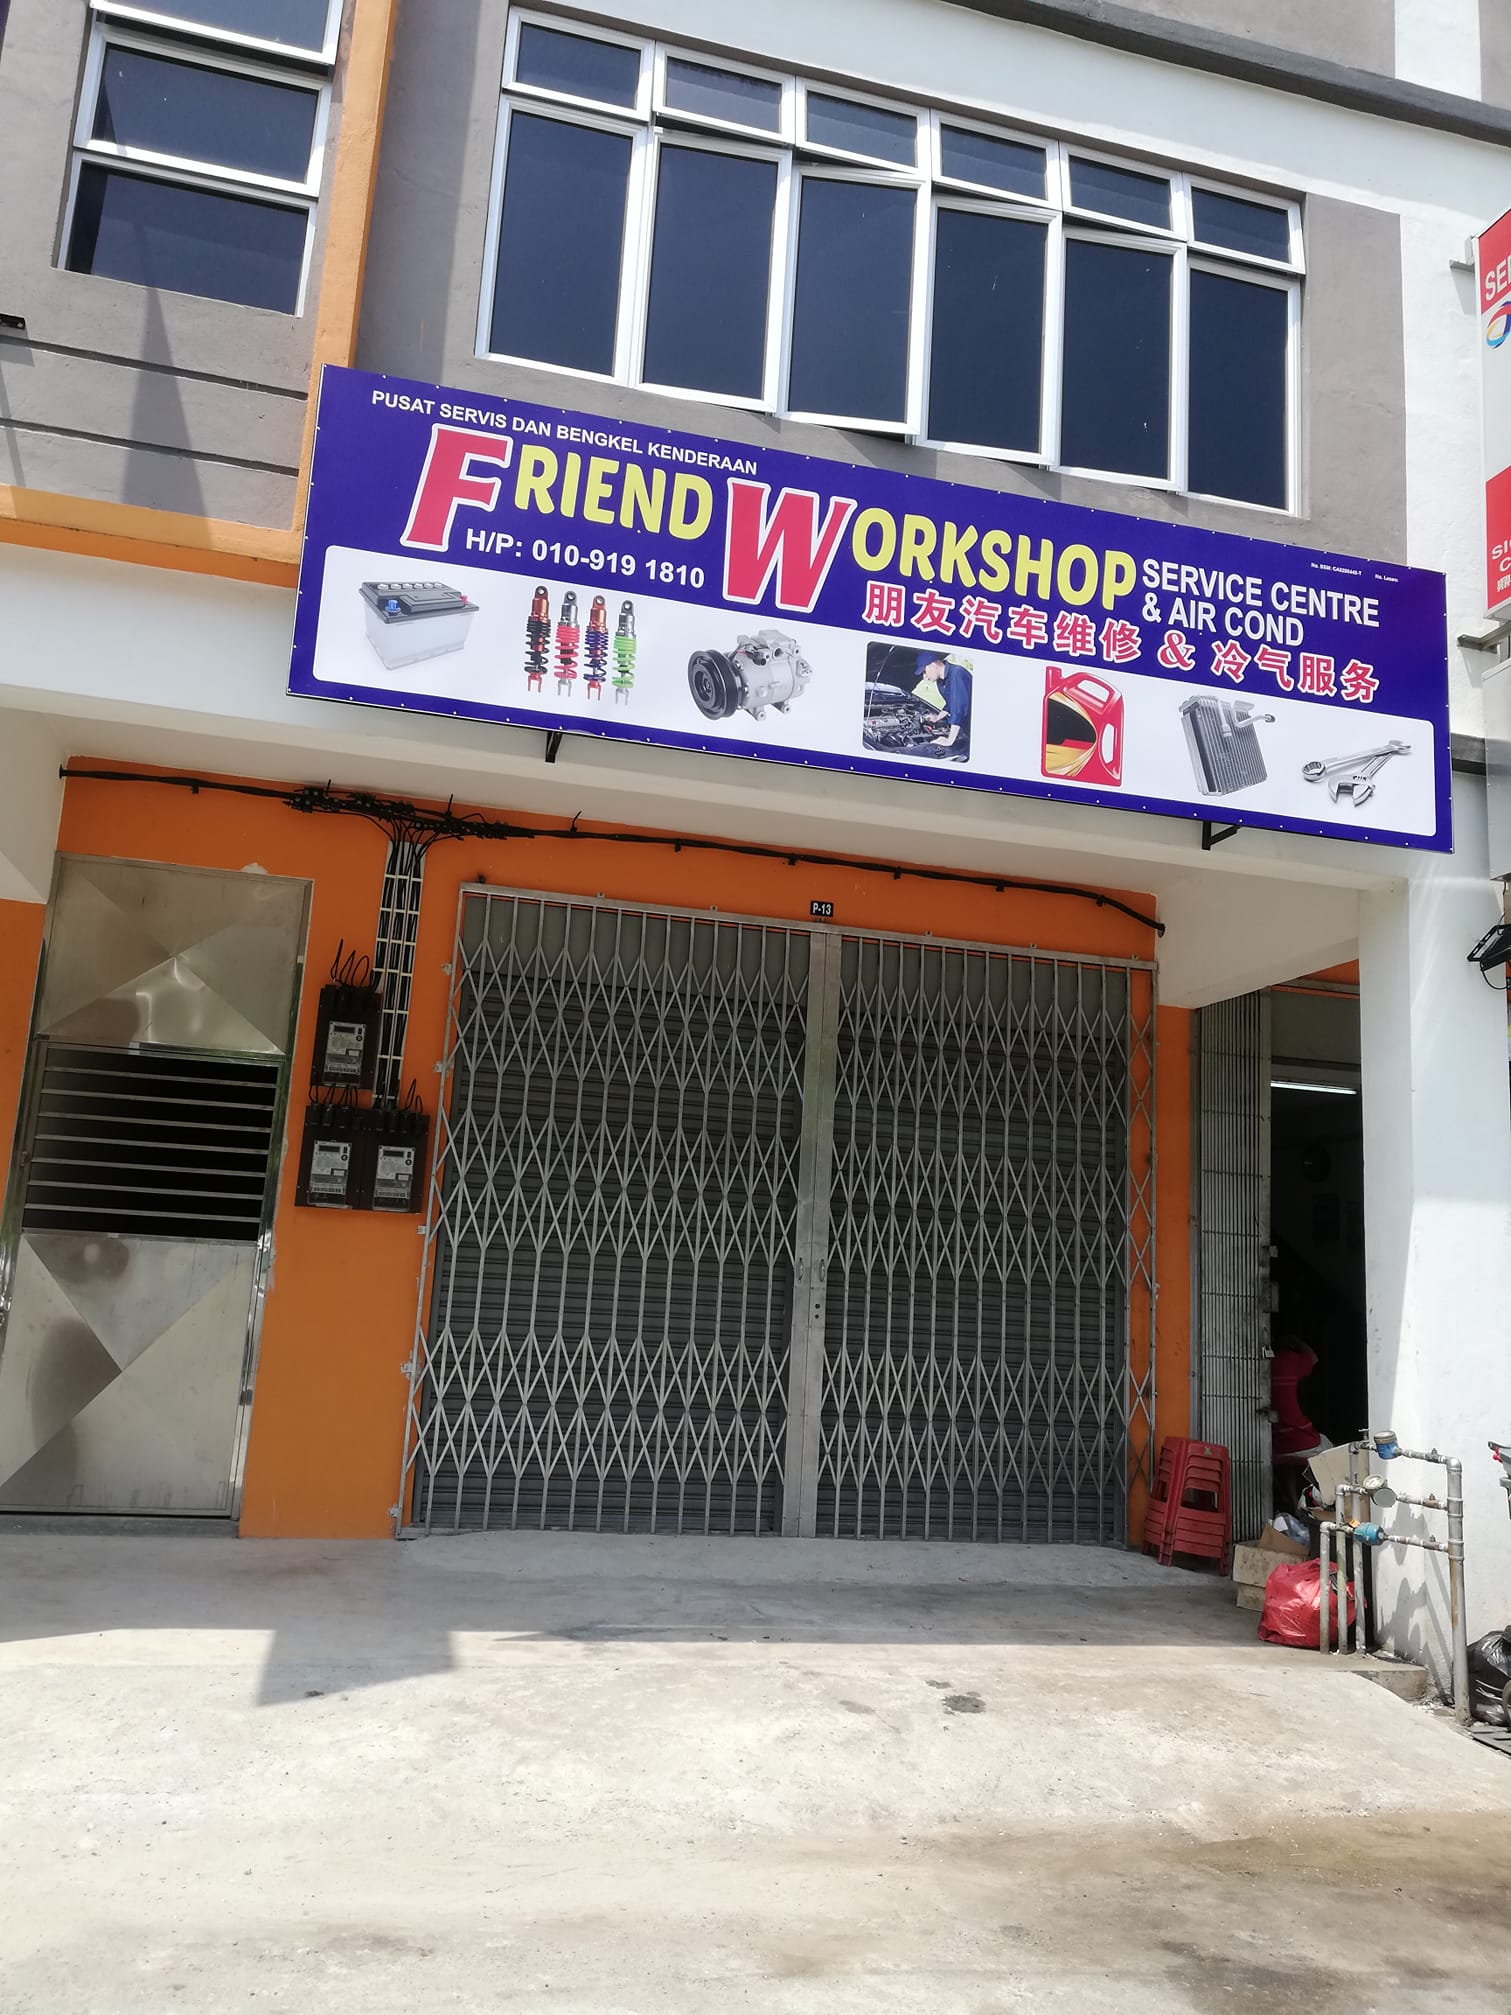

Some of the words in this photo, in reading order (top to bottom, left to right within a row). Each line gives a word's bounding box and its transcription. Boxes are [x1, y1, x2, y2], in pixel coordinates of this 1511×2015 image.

[372, 390, 435, 415] PUSAT
[439, 403, 507, 428] SERVIS
[512, 416, 551, 437] DAN
[556, 424, 643, 454] BENGKEL
[648, 442, 757, 475] KENDERAAN
[400, 423, 713, 552] FRIEND
[722, 477, 1137, 613] WORKSHOP
[1491, 539, 1511, 560] SI
[466, 528, 523, 557] H/P:
[532, 539, 636, 576] 010-919
[645, 559, 705, 588] 1810
[1142, 558, 1263, 607] SERVICE
[1270, 581, 1380, 627] CENTRE
[1142, 592, 1161, 623] &
[1168, 597, 1217, 633] AIR
[1224, 606, 1304, 647] COND
[862, 580, 1142, 663] 朋友汽车维修
[1157, 629, 1196, 671] &
[1210, 638, 1380, 704] 冷气服务
[812, 902, 832, 915] P-13
